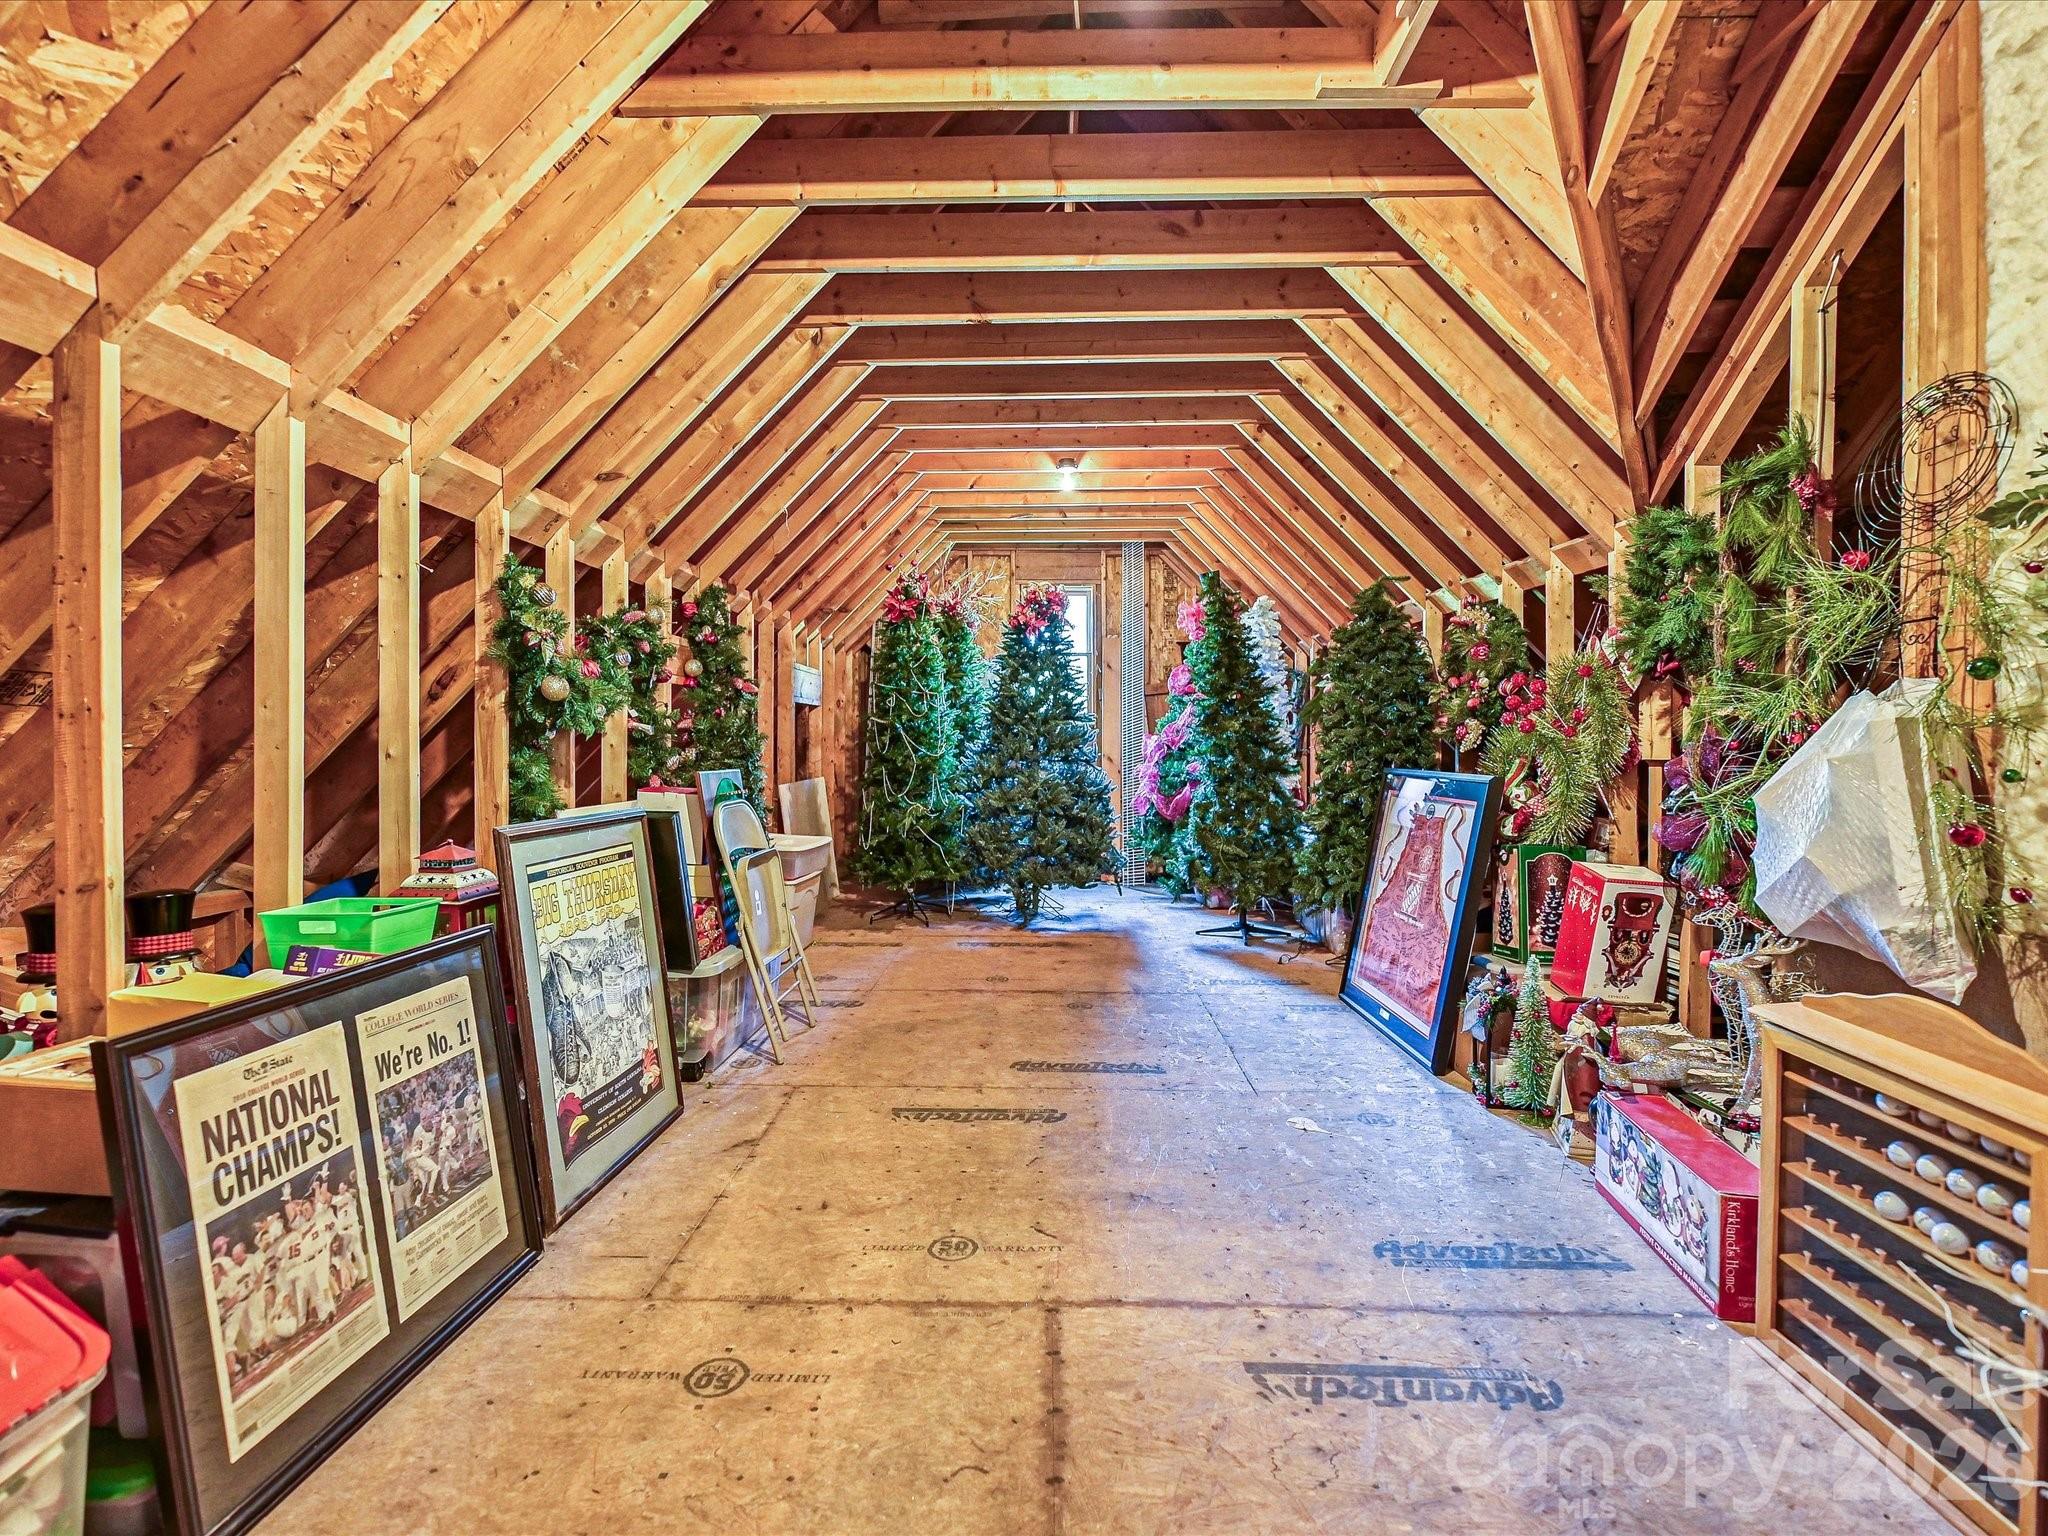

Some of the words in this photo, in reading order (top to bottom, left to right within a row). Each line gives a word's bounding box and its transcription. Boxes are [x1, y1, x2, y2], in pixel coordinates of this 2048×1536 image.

[547, 864, 575, 877] HISTORICAL
[599, 853, 619, 865] PROGRAM
[532, 882, 561, 930] BIG
[562, 862, 636, 918] THURSDAY
[364, 1011, 403, 1033] COLLEGE
[404, 1002, 434, 1018] WORLD
[434, 992, 459, 1006] SERIES
[374, 1045, 422, 1083] We're
[427, 1031, 453, 1060] No.
[457, 1017, 471, 1046] 1!
[243, 1067, 262, 1081] The
[270, 1054, 294, 1071] State
[1010, 1060, 1146, 1073] AdvanTech
[247, 1083, 270, 1097] COLLEGE
[271, 1075, 289, 1089] WORLD
[289, 1067, 306, 1080] SERIES
[582, 1090, 608, 1110] UNIVERSITY
[597, 1099, 617, 1114] CLEMSON
[617, 1086, 633, 1101] COLLEGE
[200, 1069, 340, 1164] NATIONAL
[917, 1109, 1067, 1124] AdvanTech
[213, 1108, 342, 1207] CHAMPS!
[1725, 1201, 1741, 1258] Kirkland's
[288, 1242, 301, 1260] 15
[939, 1240, 969, 1250] 50
[983, 1244, 1065, 1252] WARRANTY
[1373, 1240, 1585, 1267] AdvanTech
[1654, 1243, 1683, 1276] CHARACTERS
[1725, 1259, 1740, 1294] Home
[579, 1369, 681, 1382] WARRANTY
[693, 1371, 737, 1390] 50
[1294, 1374, 1565, 1412] AdvanTech
